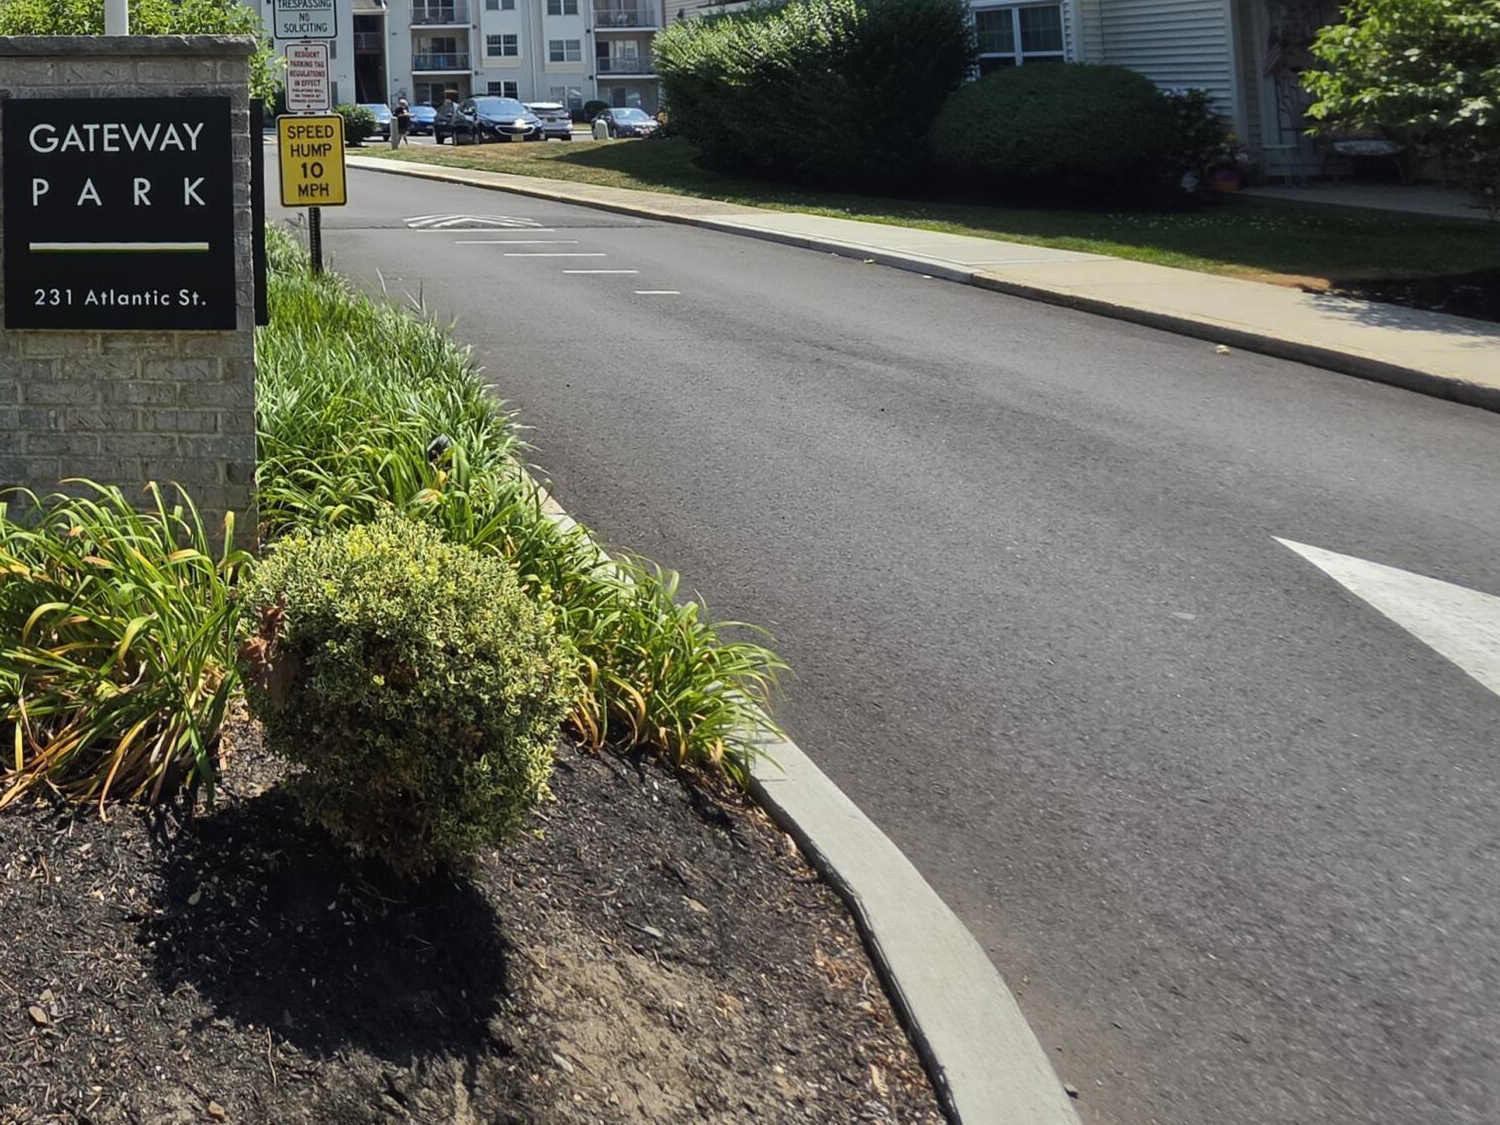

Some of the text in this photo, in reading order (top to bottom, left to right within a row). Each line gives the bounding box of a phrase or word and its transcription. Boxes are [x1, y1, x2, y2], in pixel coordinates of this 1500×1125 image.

[299, 13, 311, 22] NO
[283, 22, 328, 33] SOLICITING
[29, 123, 204, 153] GATEWAY
[287, 125, 334, 139] SPEED
[290, 143, 332, 158] HUMP
[301, 162, 324, 179] 10
[32, 177, 206, 206] PARK
[298, 183, 329, 197] MPH
[34, 289, 207, 306] 231 Atlantic St.
